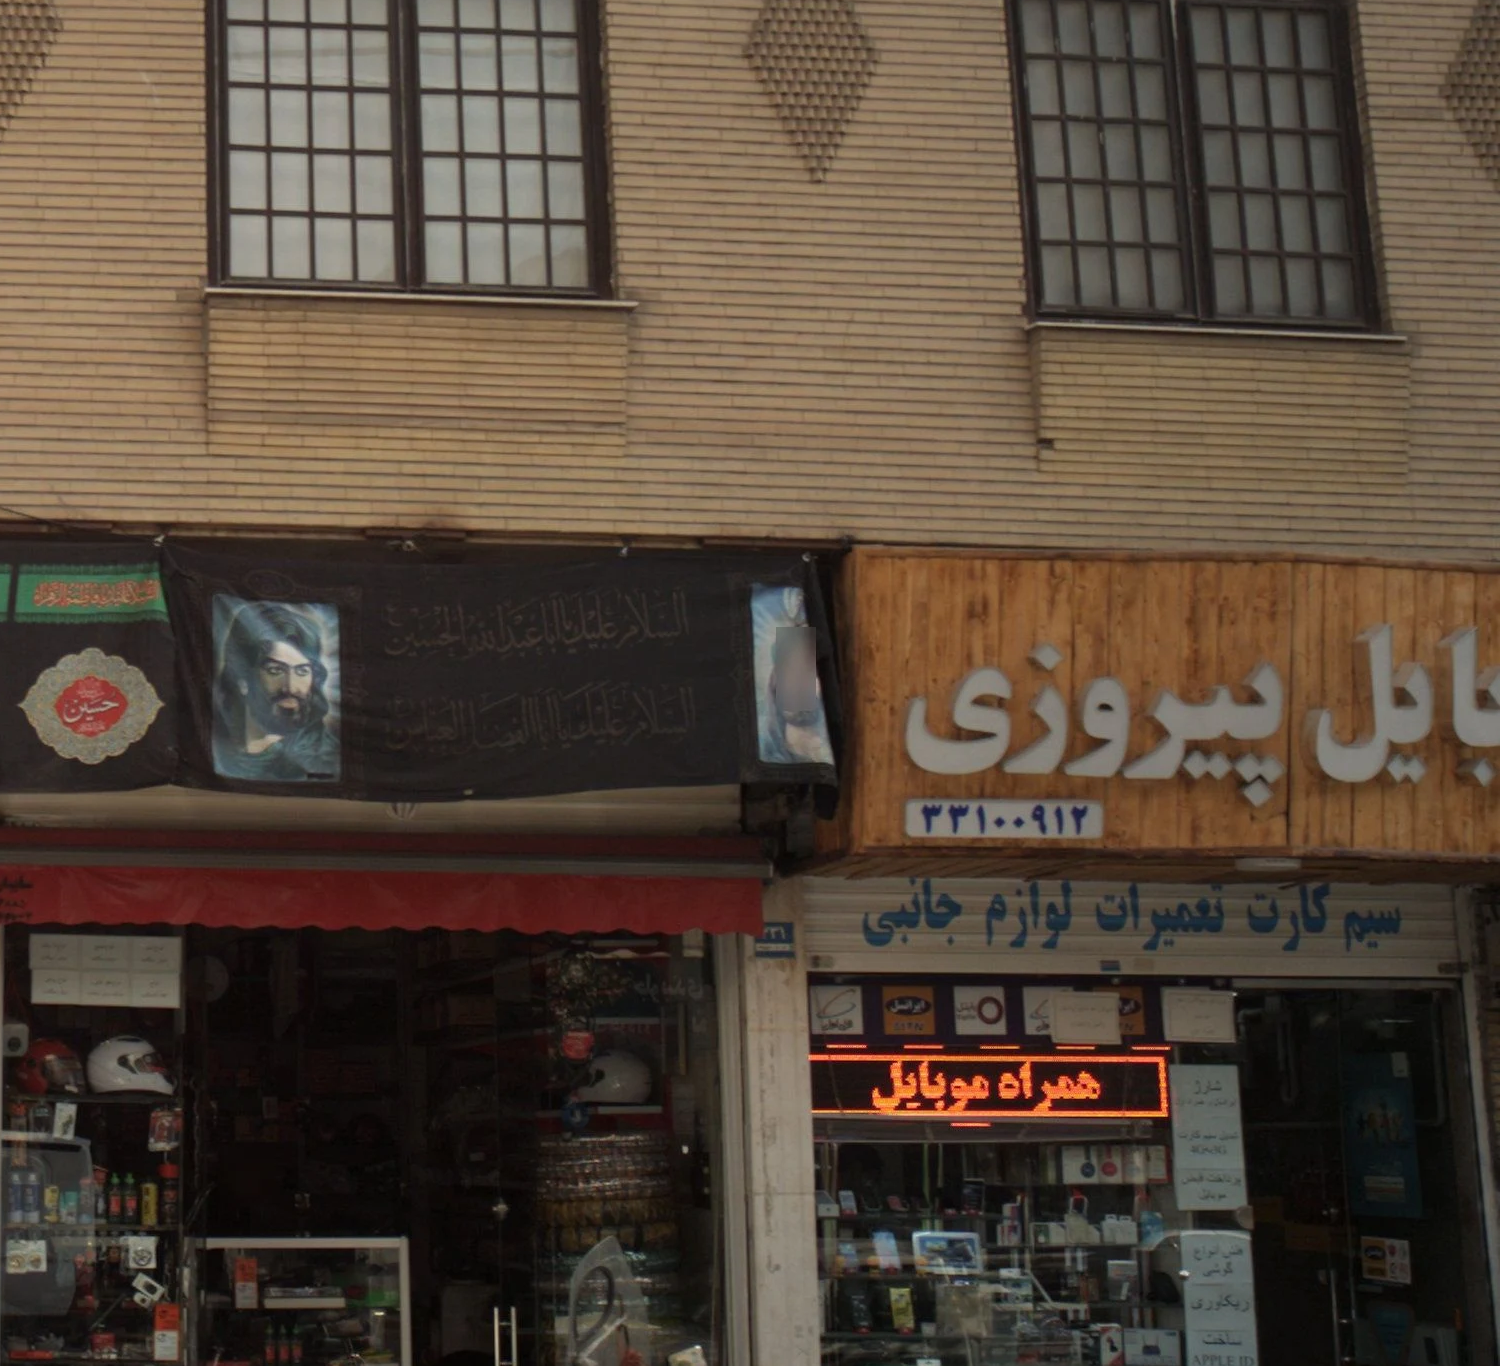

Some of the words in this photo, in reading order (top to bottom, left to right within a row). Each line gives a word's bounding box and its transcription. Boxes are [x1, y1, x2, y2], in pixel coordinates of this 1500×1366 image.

[63, 693, 119, 723] حسین
[906, 644, 1283, 806] پیروزی
[921, 804, 1088, 835] ۳۳۱۰۰۹۱۲
[863, 877, 962, 947] جانبی
[986, 880, 1073, 949] لوازم
[1097, 881, 1225, 951] تعمیرات
[1247, 881, 1330, 951] کارت
[1344, 906, 1401, 951] سیم
[872, 1060, 989, 1113] موبایل
[998, 1060, 1101, 1111] همراه
[1203, 1262, 1233, 1277] گوشی
